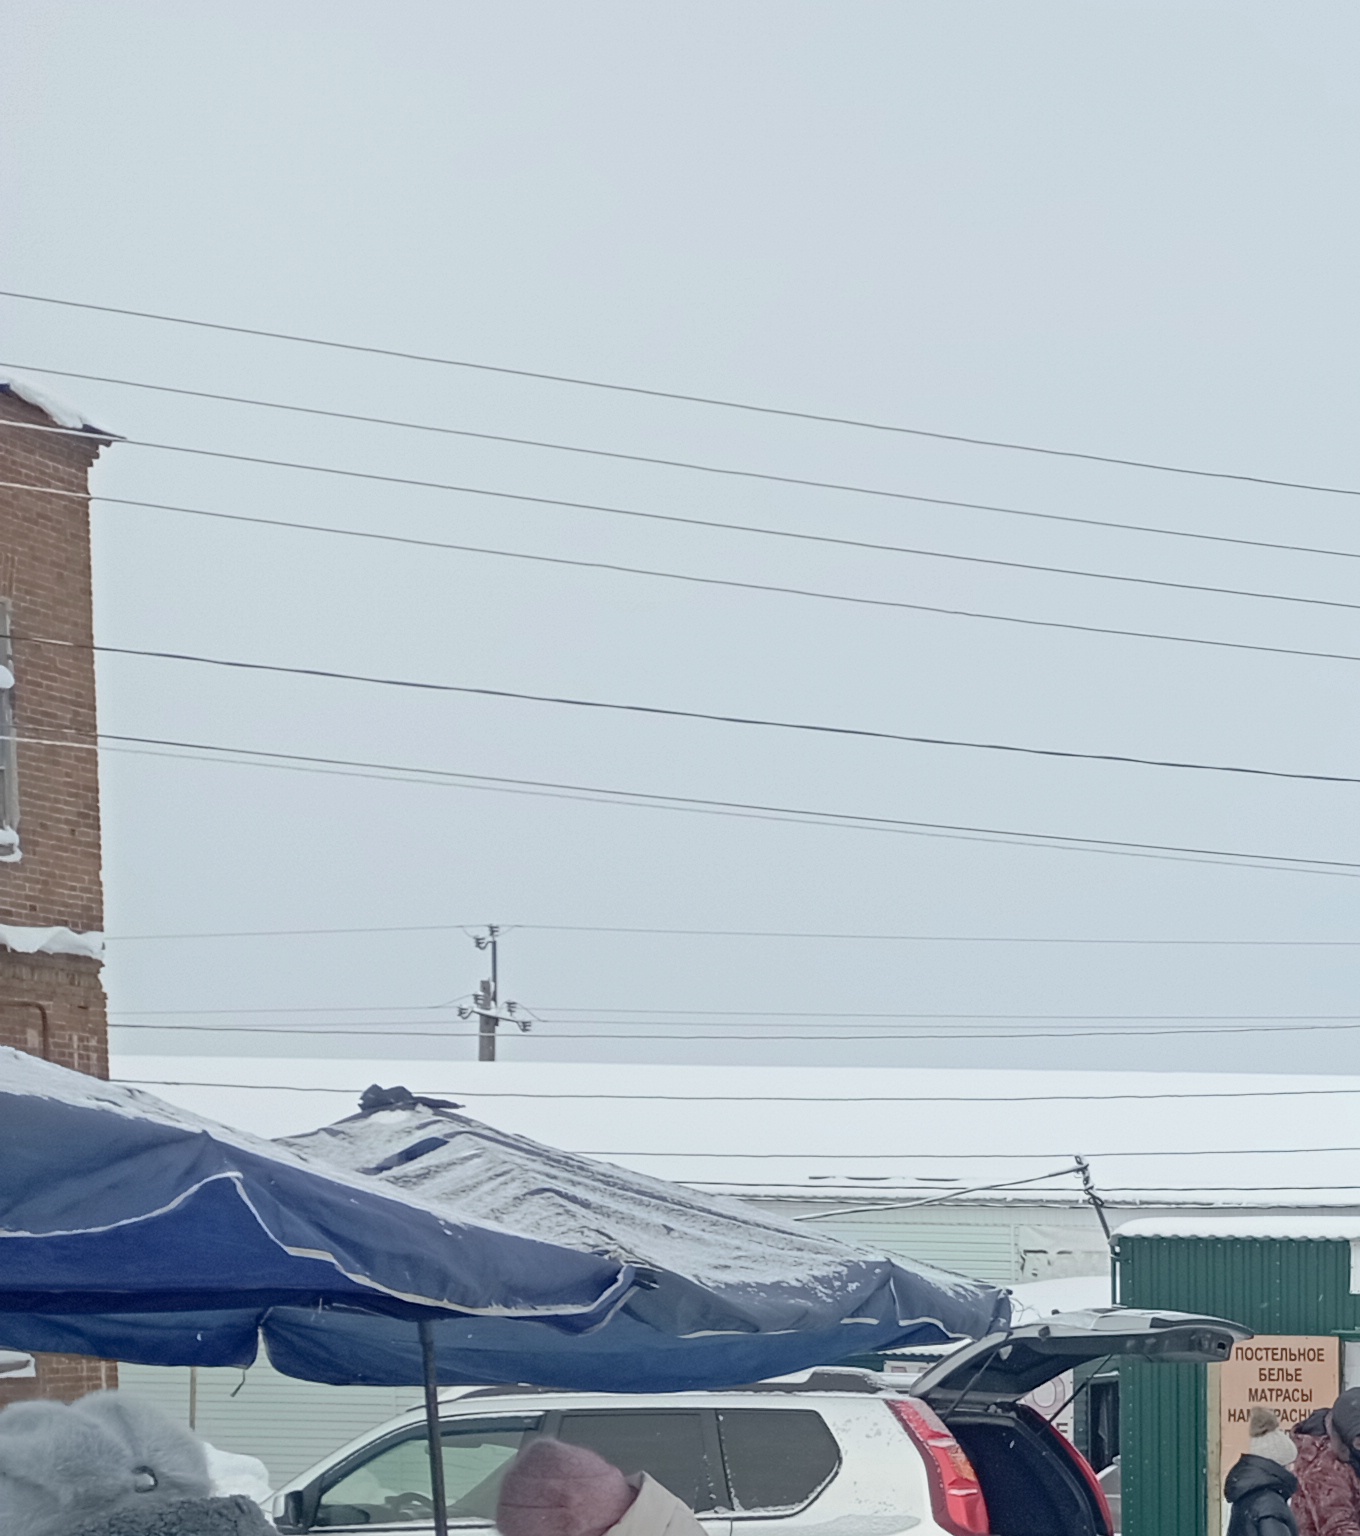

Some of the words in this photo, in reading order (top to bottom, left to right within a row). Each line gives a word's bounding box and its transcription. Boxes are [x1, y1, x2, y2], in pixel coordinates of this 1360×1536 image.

[1235, 1347, 1325, 1362] ПОСТЕЛЬНОЕ
[1258, 1368, 1302, 1382] БЕЛЬЕ
[1248, 1388, 1313, 1403] МАТРАСЫ
